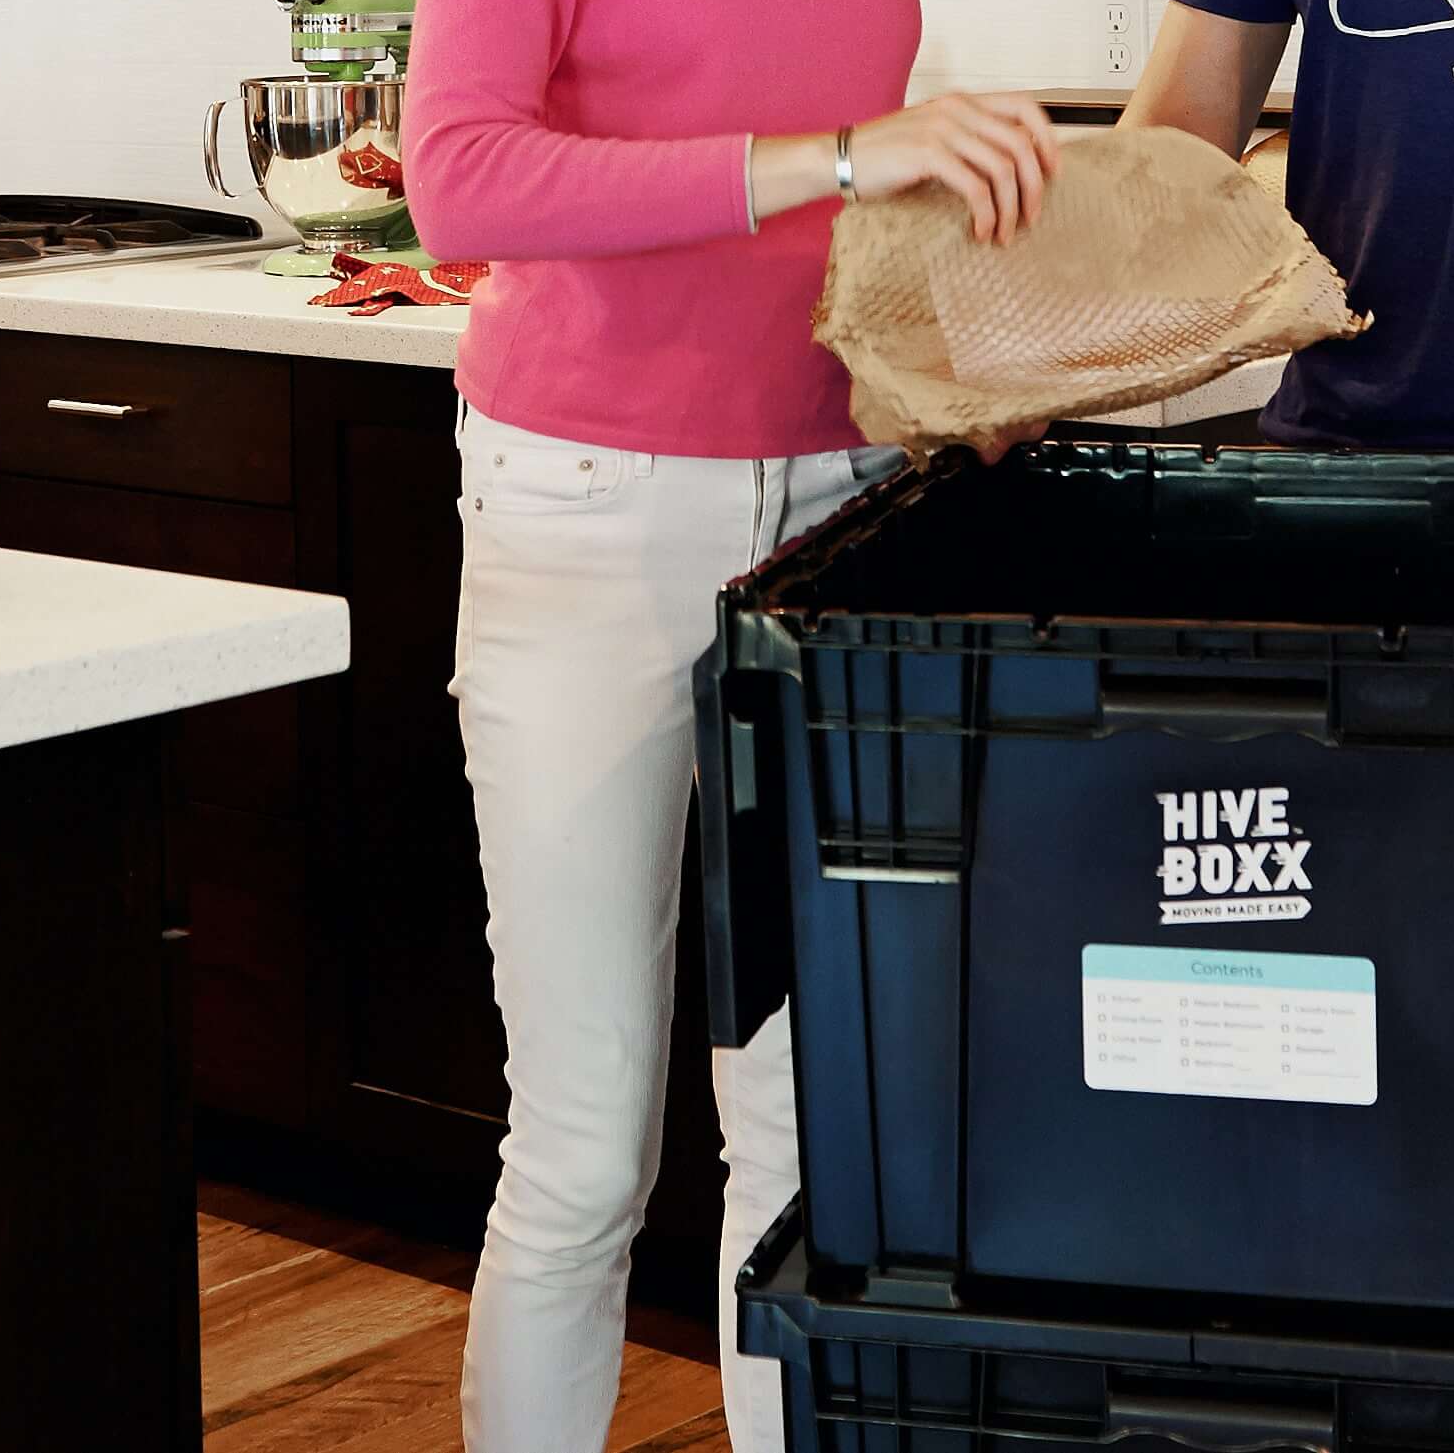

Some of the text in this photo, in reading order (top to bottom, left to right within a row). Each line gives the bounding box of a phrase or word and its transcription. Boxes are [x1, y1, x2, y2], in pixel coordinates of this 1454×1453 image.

[1157, 787, 1290, 842] HIVE
[1157, 840, 1313, 896] BOXX
[1172, 901, 1301, 918] MOVING MADE EASY
[1190, 961, 1265, 979] Contents
